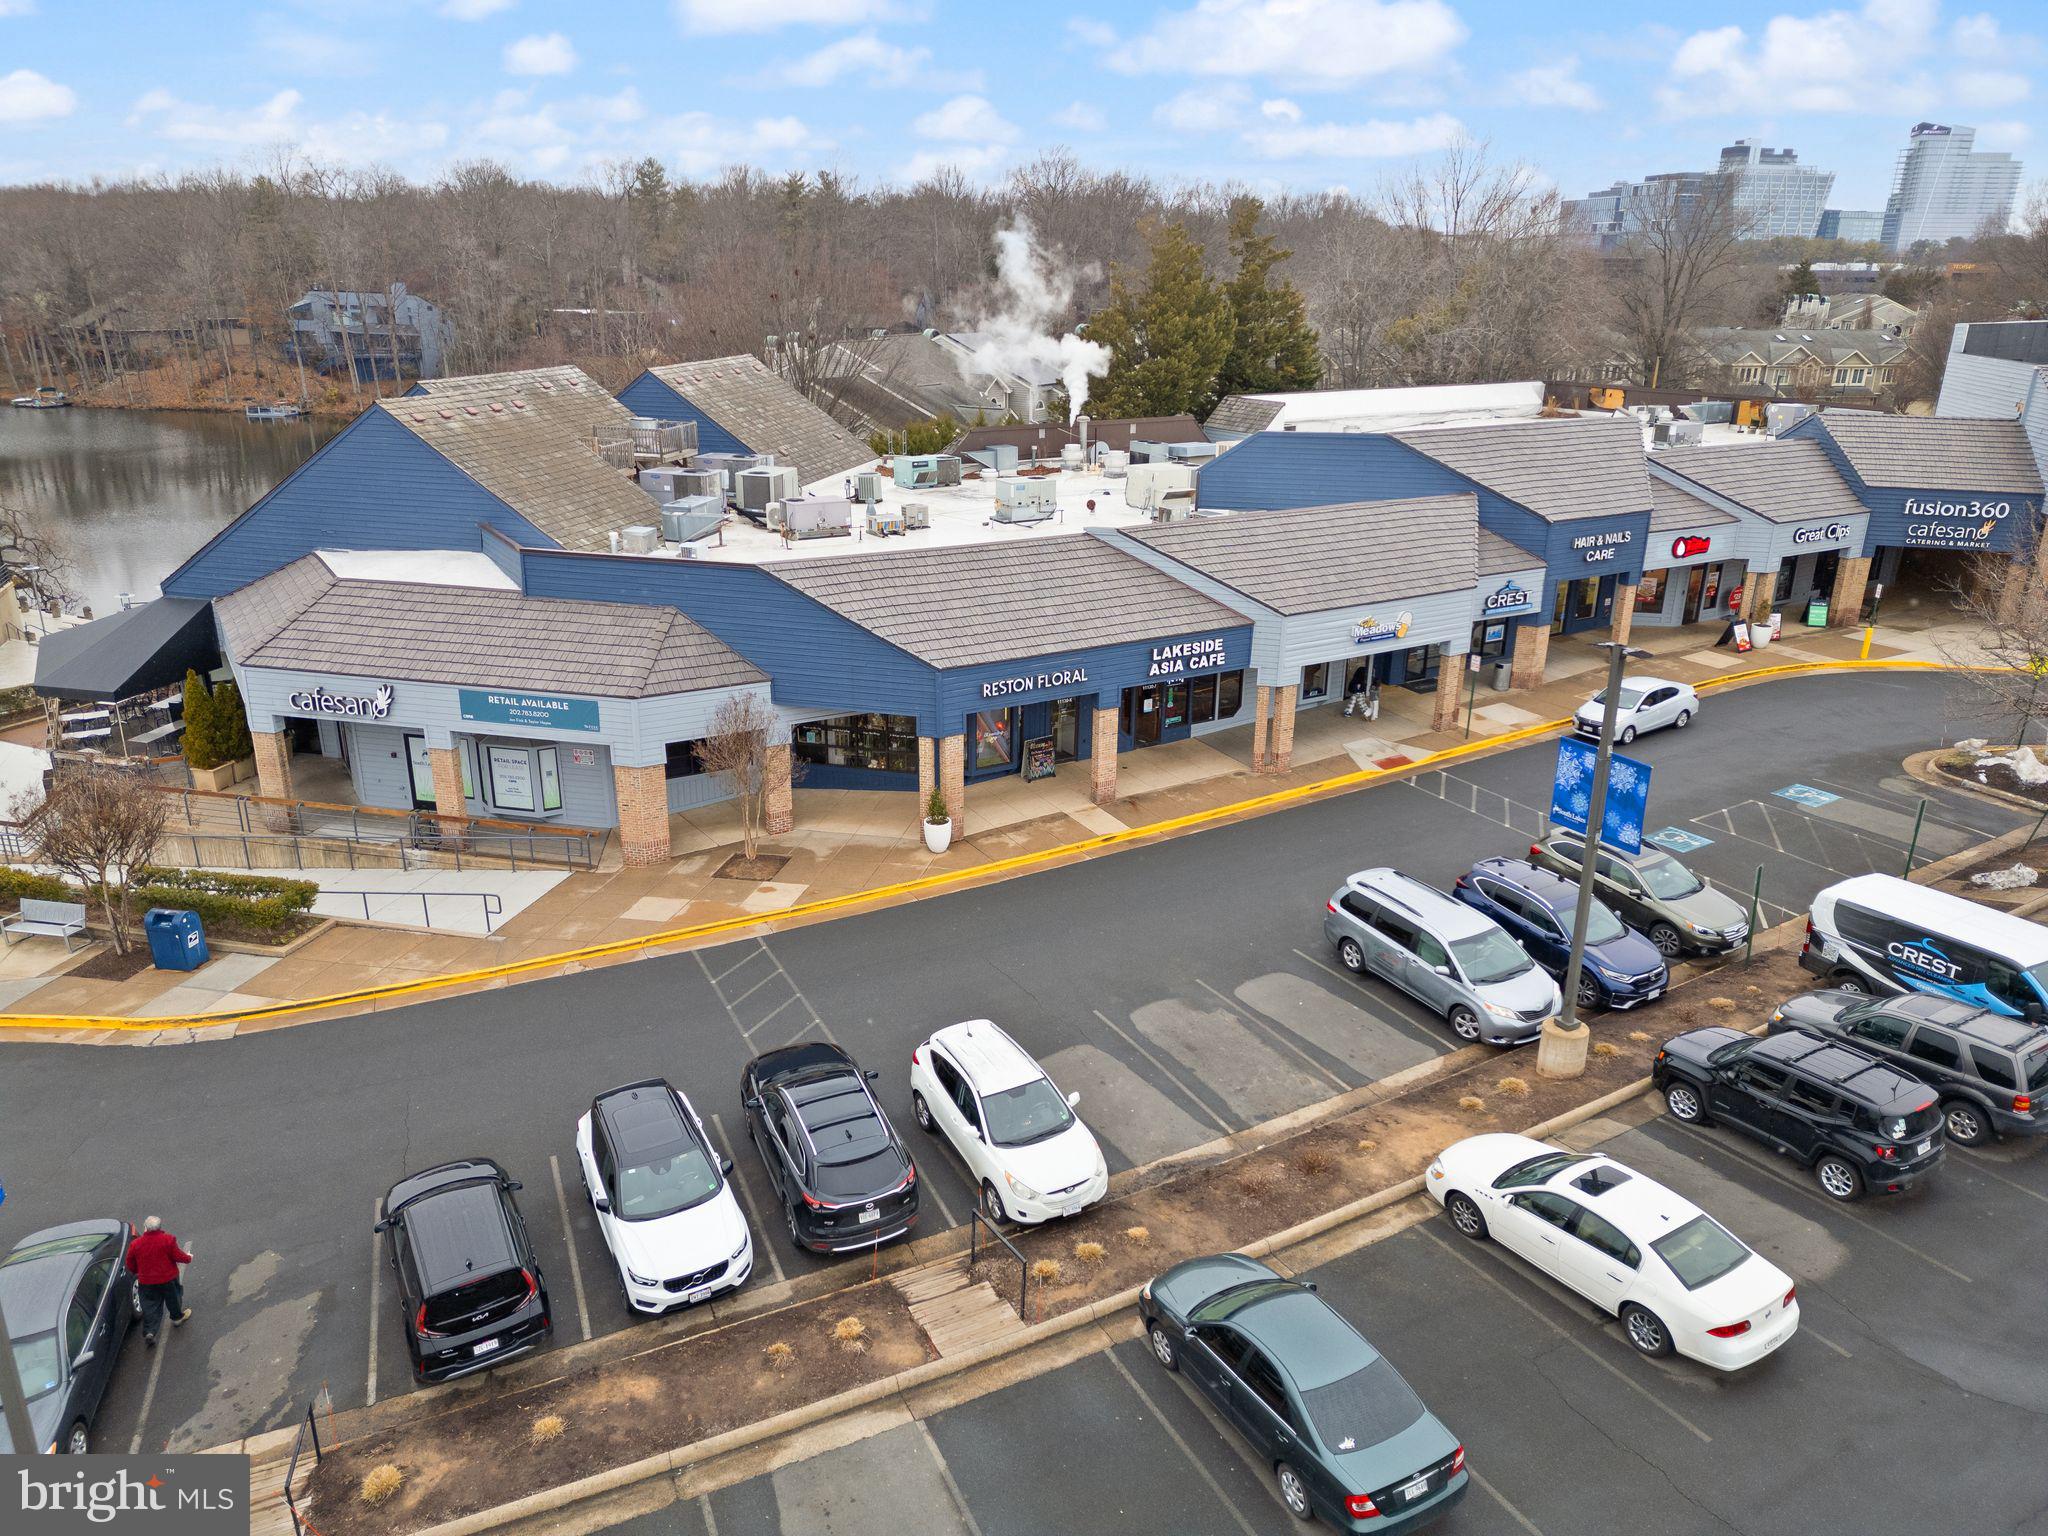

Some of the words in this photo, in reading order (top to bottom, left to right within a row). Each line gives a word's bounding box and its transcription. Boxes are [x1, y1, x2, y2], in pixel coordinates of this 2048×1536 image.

[1903, 498, 2010, 519] fusion360
[1574, 536, 1595, 549] HAIR
[1596, 535, 1604, 546] &
[1605, 531, 1631, 545] NAILS
[1794, 528, 1825, 543] Great
[1827, 524, 1851, 541] Clips
[1908, 521, 1989, 541] cafesano
[1905, 538, 1946, 546] CATERING
[1586, 548, 1615, 562] CARE
[1487, 590, 1533, 608] CREST
[1352, 623, 1402, 637] Meadows
[1152, 639, 1223, 661] LAKESIDE
[1149, 659, 1184, 676] ASIA
[1189, 653, 1226, 669] CAFE
[983, 677, 1033, 698] RESTON
[1037, 668, 1088, 689] FLORAL
[288, 687, 389, 720] cafesano
[488, 695, 519, 707] RETAIL
[521, 699, 569, 711] AVAILABLE
[1887, 942, 1962, 979] CREST
